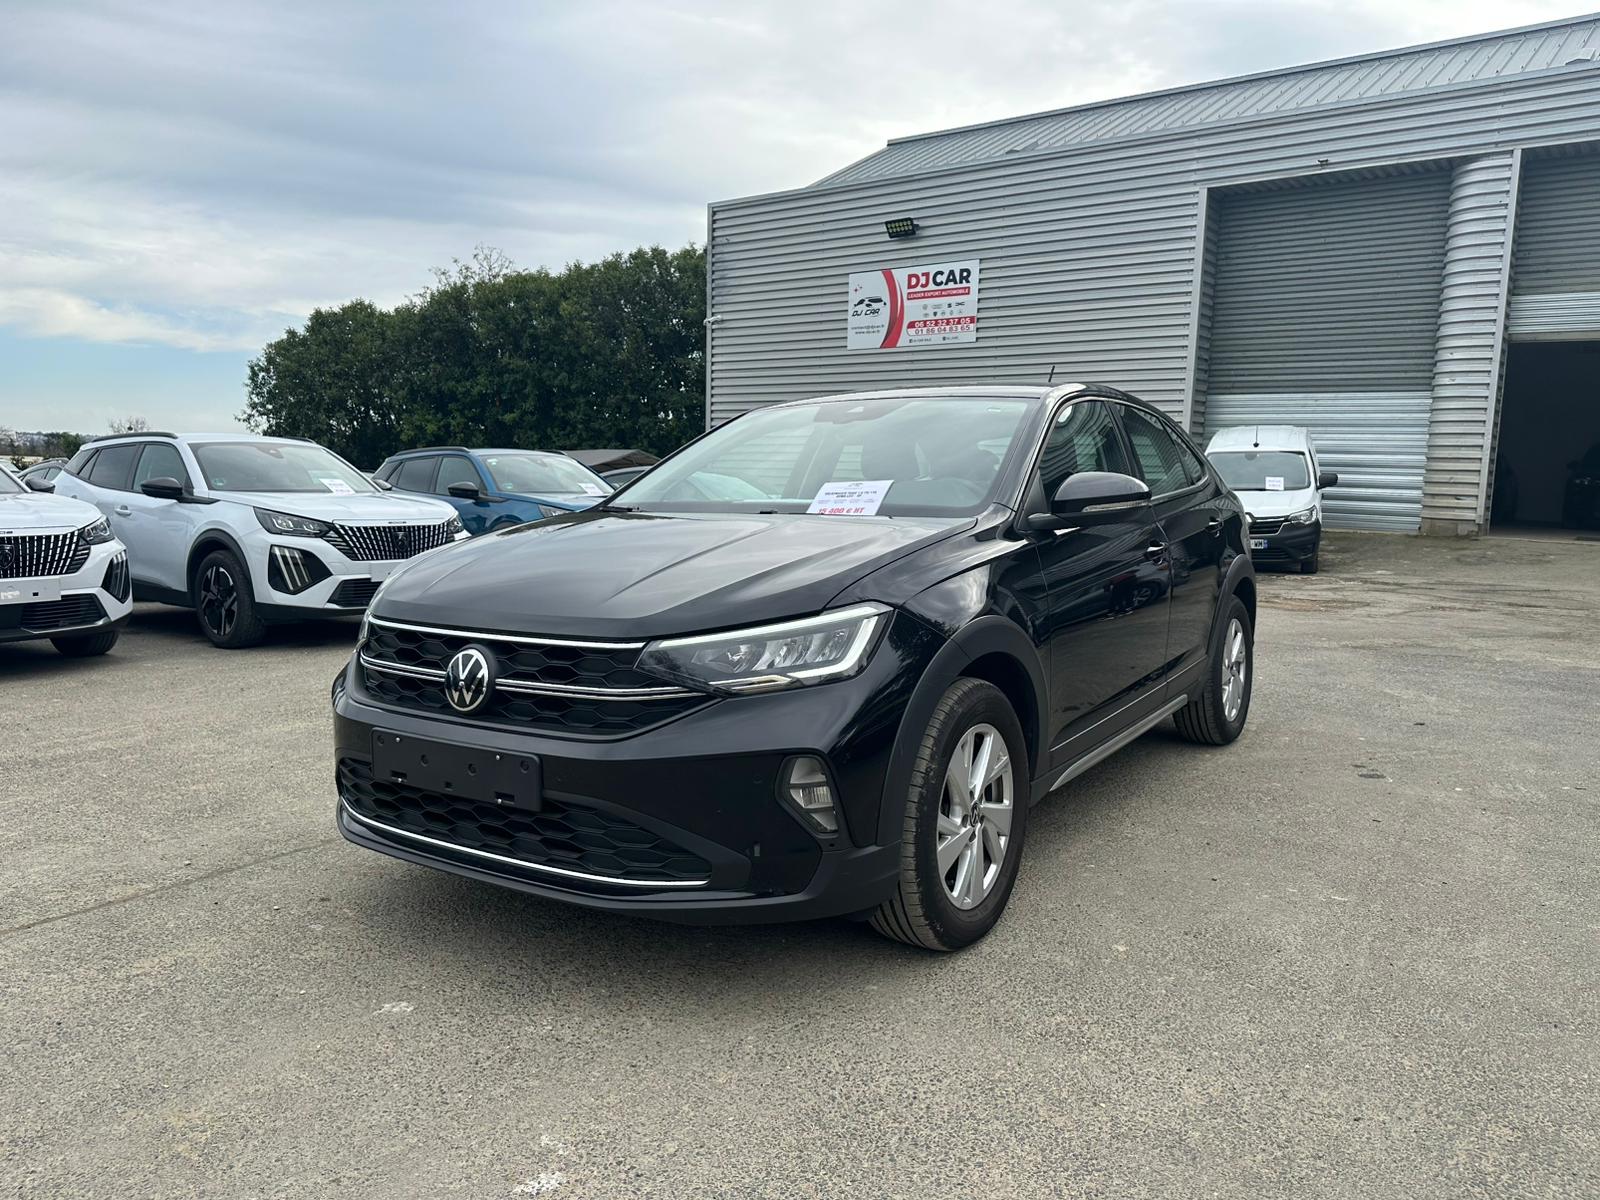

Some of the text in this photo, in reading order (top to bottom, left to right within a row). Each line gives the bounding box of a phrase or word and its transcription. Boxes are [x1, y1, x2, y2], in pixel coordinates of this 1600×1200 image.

[907, 268, 971, 289] DJ CAR
[942, 288, 969, 296] AUTOMOBILE
[852, 308, 881, 317] DJ CAR
